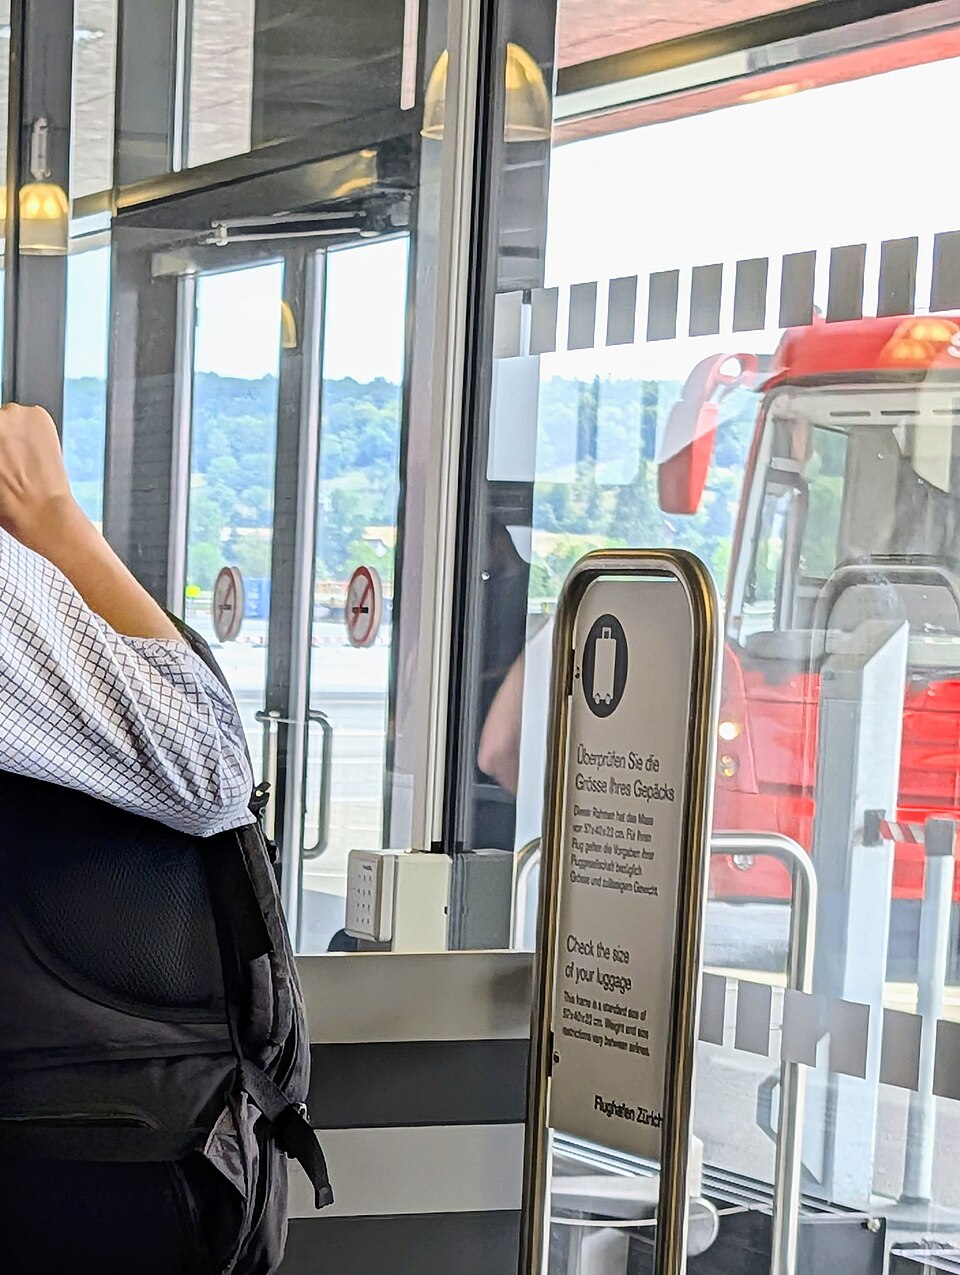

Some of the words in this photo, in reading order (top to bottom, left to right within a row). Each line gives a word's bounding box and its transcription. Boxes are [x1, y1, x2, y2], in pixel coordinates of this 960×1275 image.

[628, 751, 643, 771] Sie
[645, 754, 660, 772] die
[567, 934, 595, 957] Check
[597, 941, 610, 960] the
[612, 945, 630, 964] size
[565, 962, 574, 978] of
[575, 967, 595, 984] your
[597, 967, 632, 994] luggage
